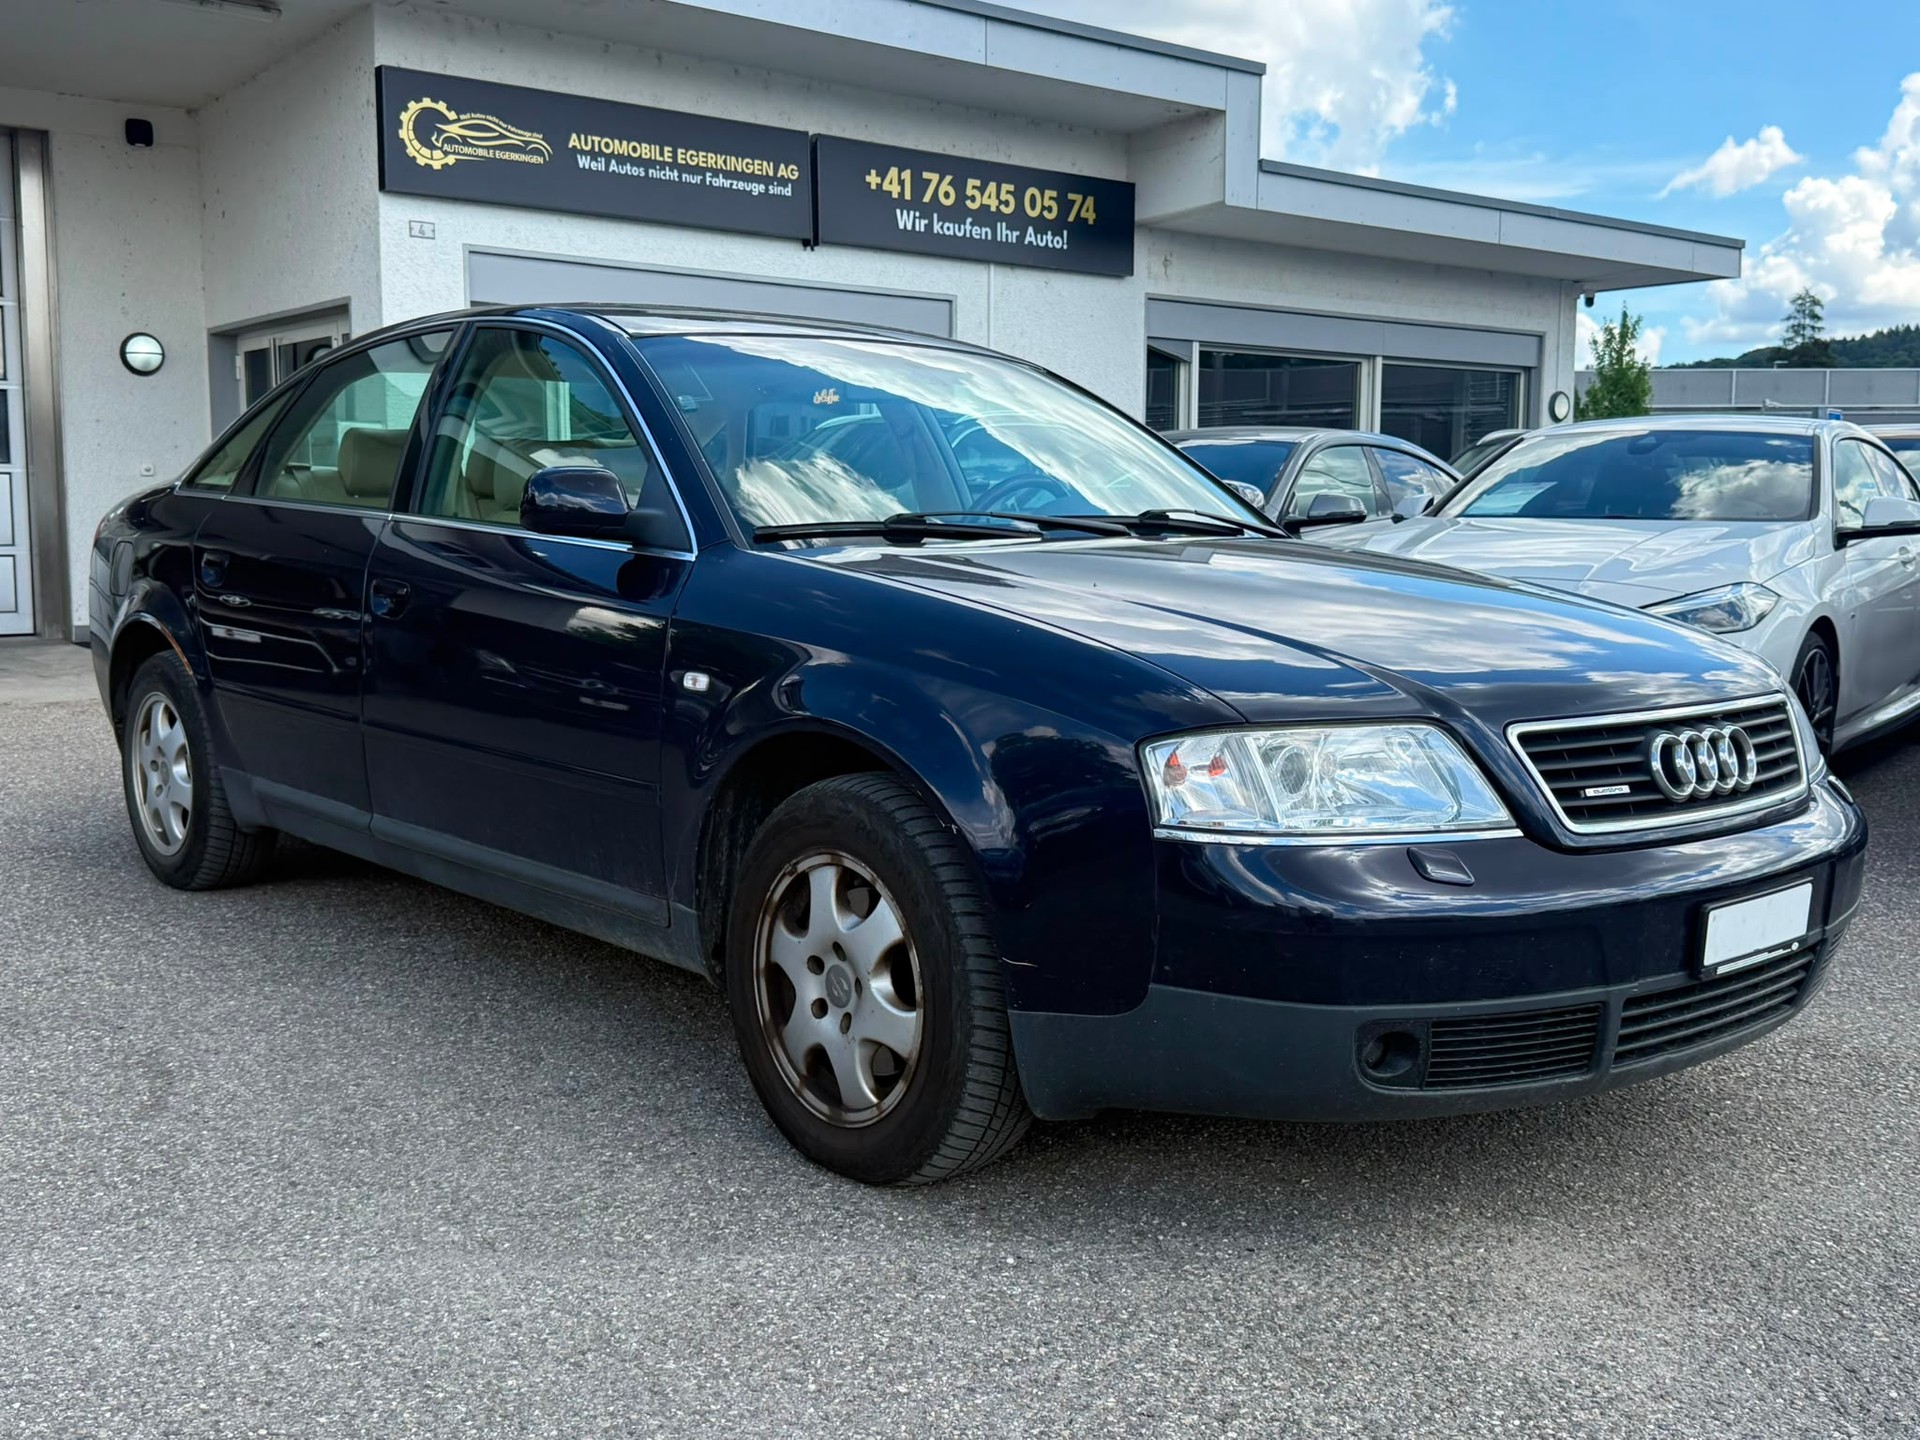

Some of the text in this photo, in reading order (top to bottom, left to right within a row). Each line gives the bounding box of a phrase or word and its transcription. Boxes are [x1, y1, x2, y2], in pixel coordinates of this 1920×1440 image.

[471, 112, 485, 120] Autos
[486, 114, 499, 123] nicht
[507, 124, 532, 138] Fahrzeuge
[532, 131, 544, 139] sind
[443, 143, 544, 165] AUTOMOBILE EGERKINGEN
[568, 133, 799, 180] AUTOMOBILE EGERKINGEN AG
[576, 154, 792, 197] Weil Autos nicht nur Fahrzeuge sind
[865, 166, 1097, 225] +41 76 545 05 74
[895, 209, 1068, 250] Wir kaufen Ihr Auto!
[1592, 787, 1624, 795] quattro
